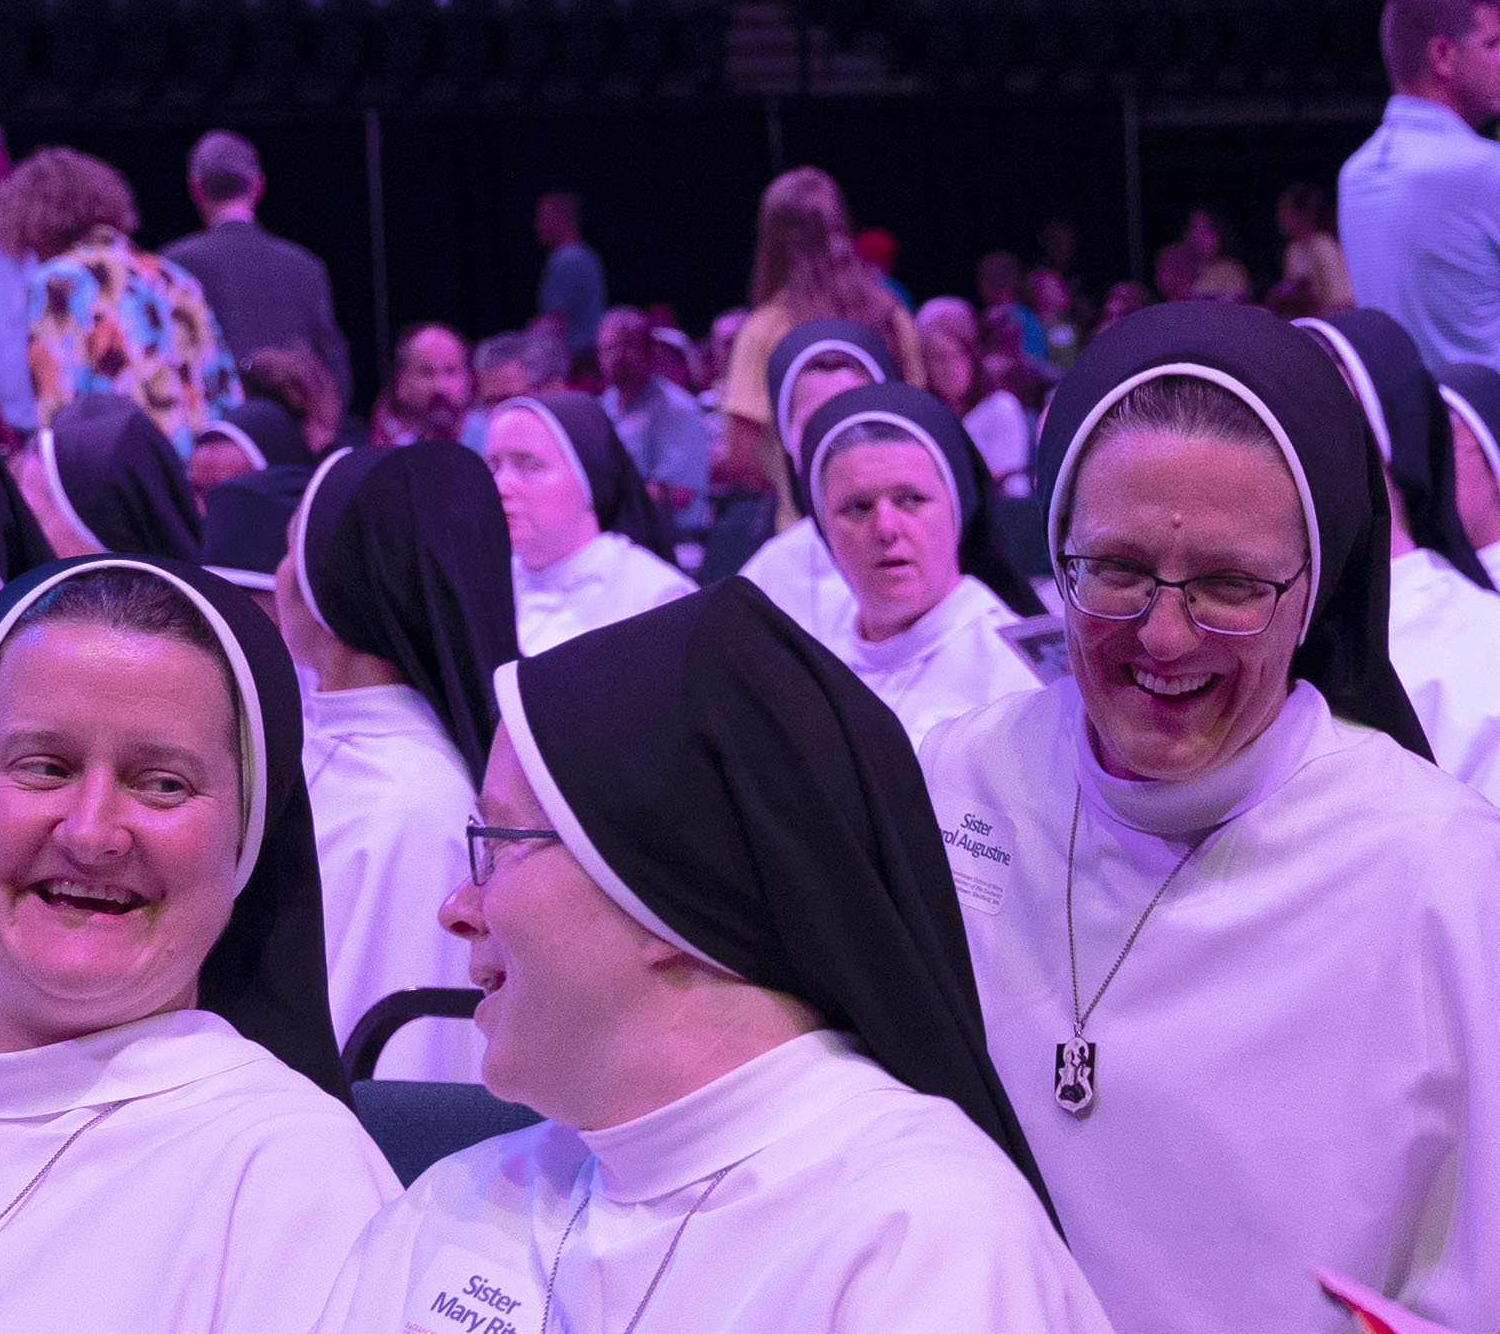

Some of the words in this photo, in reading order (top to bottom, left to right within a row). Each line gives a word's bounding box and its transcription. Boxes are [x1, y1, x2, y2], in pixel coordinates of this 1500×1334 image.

[960, 813, 993, 836] Sister
[941, 829, 959, 845] rol
[956, 833, 1010, 866] Augustine
[430, 1291, 487, 1333] Mary
[462, 1275, 521, 1315] Sister
